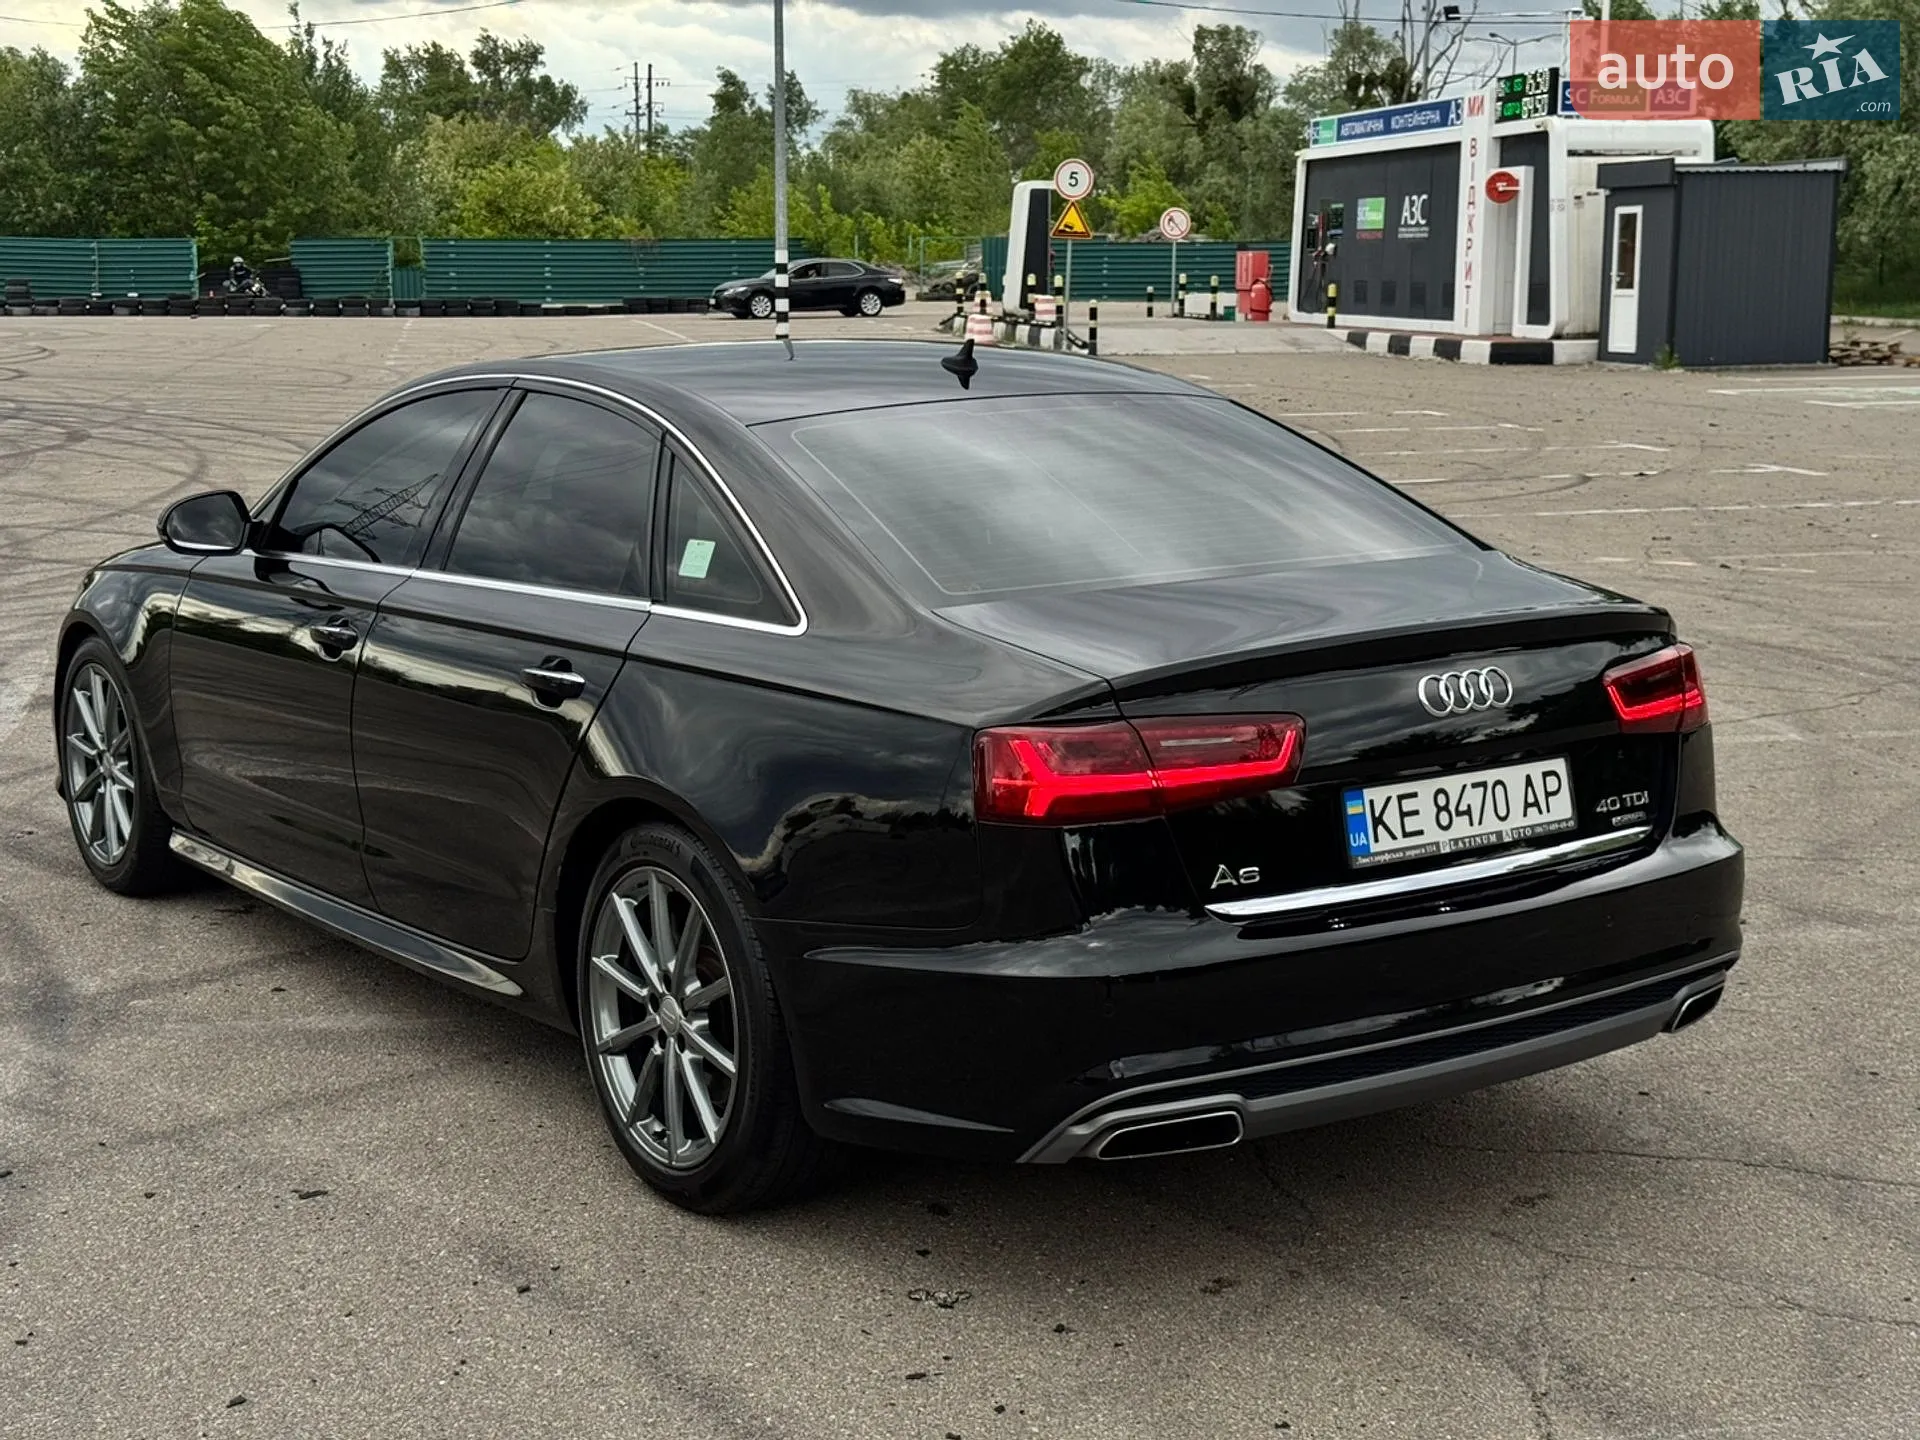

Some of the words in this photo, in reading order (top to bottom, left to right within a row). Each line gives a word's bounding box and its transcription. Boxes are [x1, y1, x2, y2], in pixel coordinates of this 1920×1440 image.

[1447, 99, 1464, 126] АЗ
[1467, 95, 1485, 118] МИ
[1067, 171, 1079, 188] 5
[1401, 194, 1428, 225] АЗС
[1369, 791, 1424, 843] KE
[1433, 779, 1510, 831] 8470
[1523, 770, 1562, 817] AP
[1596, 796, 1620, 813] 40
[1622, 790, 1649, 807] TDI
[1350, 832, 1367, 847] UA
[1440, 833, 1497, 853] PLATINUM
[1210, 864, 1260, 889] A6
